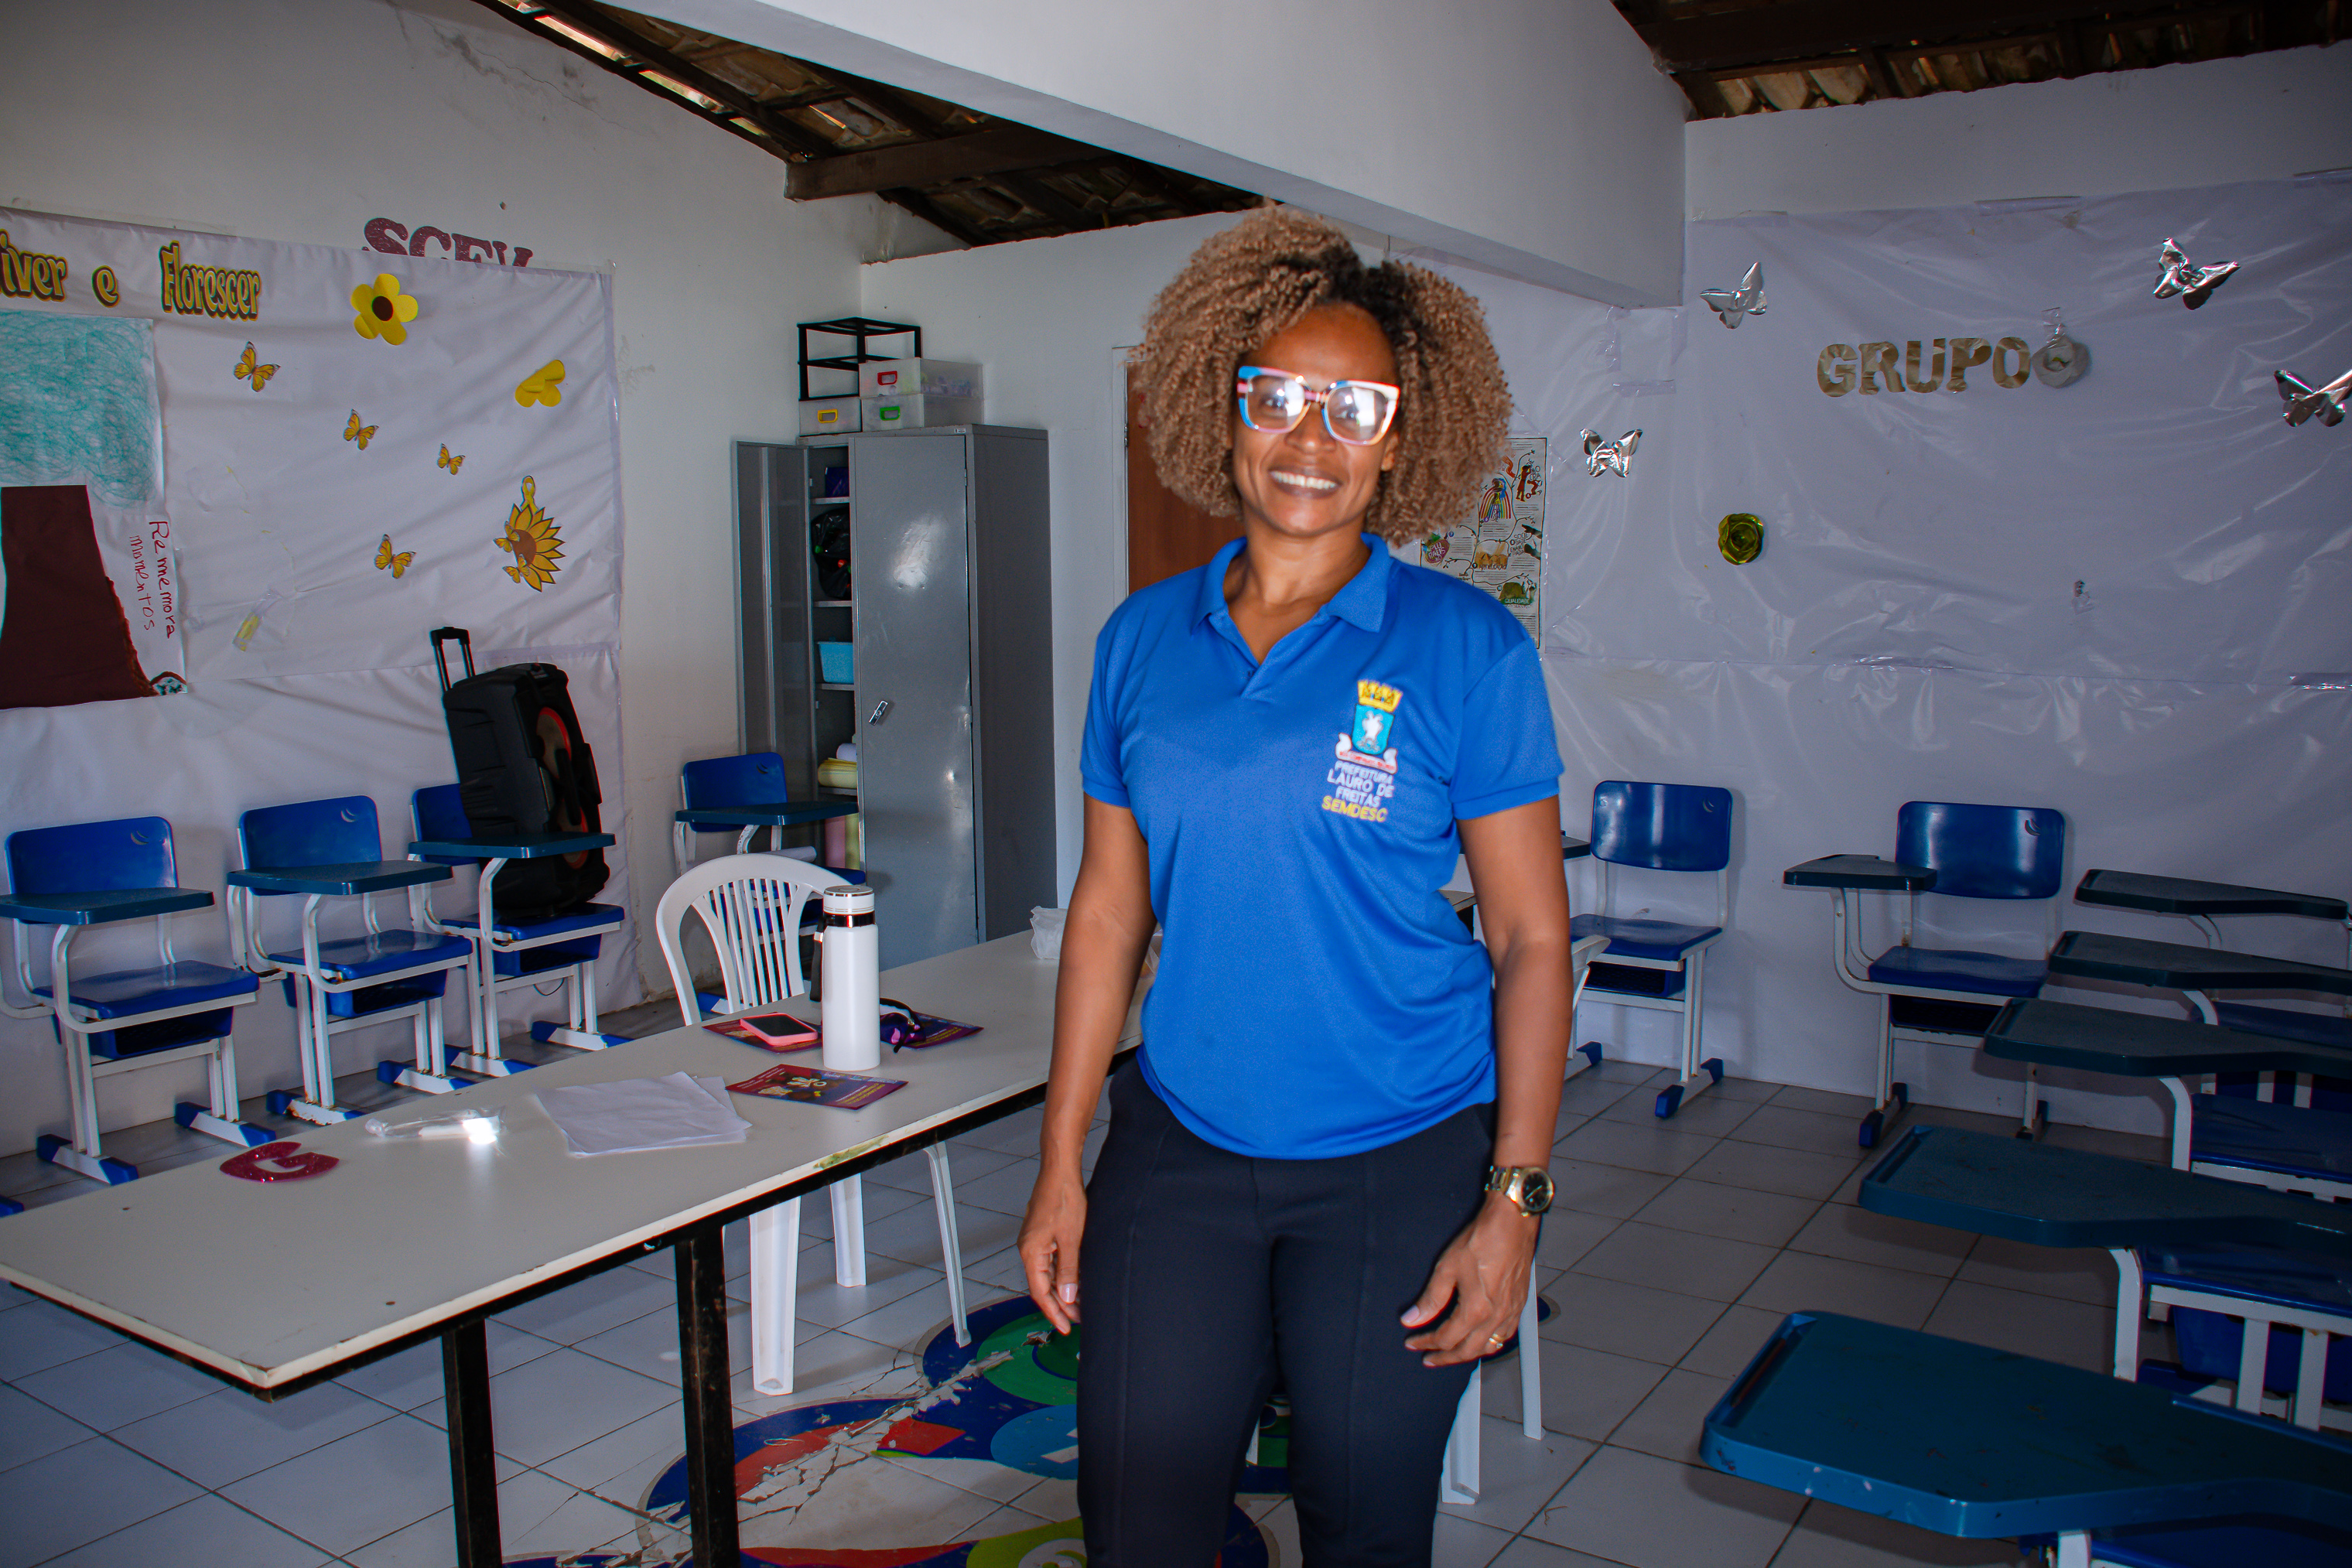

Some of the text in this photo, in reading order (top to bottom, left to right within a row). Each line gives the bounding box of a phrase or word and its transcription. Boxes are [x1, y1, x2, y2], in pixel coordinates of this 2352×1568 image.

[91, 265, 120, 308] e
[1817, 336, 2032, 398] GRUPO
[1327, 768, 1395, 798] LAURO DE
[1335, 760, 1393, 784] PREFEITURA
[1321, 795, 1388, 822] SEMDESC
[1335, 785, 1382, 808] FREITAS
